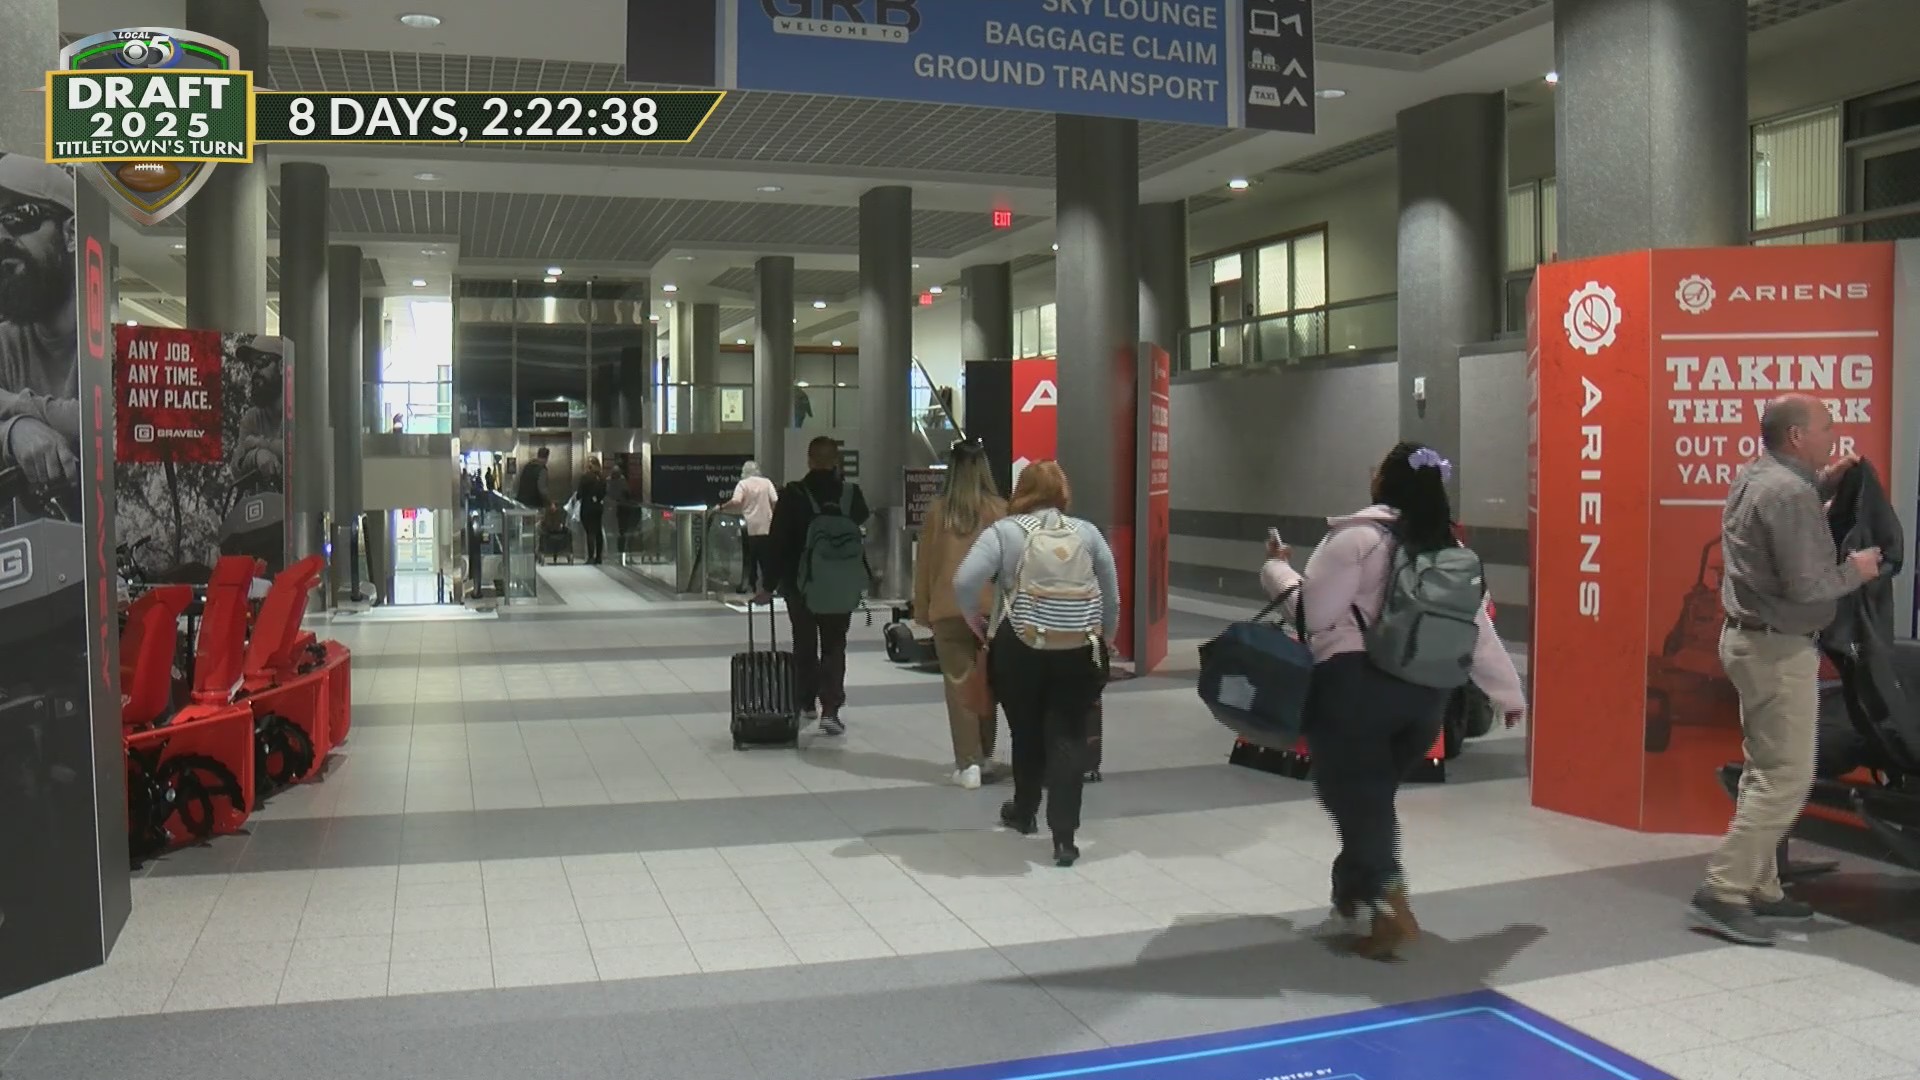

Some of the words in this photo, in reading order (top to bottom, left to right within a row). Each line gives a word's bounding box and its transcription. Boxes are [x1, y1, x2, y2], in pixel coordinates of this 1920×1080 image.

[1042, 0, 1094, 15] SKY
[1105, 0, 1217, 29] LOUNGE
[781, 21, 868, 36] WELCOME
[882, 30, 902, 38] TO
[985, 20, 1125, 55] BAGGAGE
[1132, 35, 1217, 65] CLAIM
[914, 53, 1045, 87] GROUND
[1053, 65, 1219, 102] TRANSPORT
[1255, 91, 1275, 101] TAXI
[994, 211, 1011, 226] EXIT
[1728, 283, 1869, 301] ARIENS
[128, 340, 158, 360] ANY
[164, 343, 194, 363] JOB.
[128, 364, 159, 384] ANY
[165, 367, 202, 387] TIME.
[1666, 355, 1873, 391] TAKING
[128, 388, 159, 408] ANY
[164, 390, 213, 410] PLACE.
[1668, 399, 1742, 424] THE
[1753, 398, 1872, 424] RK
[157, 428, 205, 438] GRAVELY
[1675, 436, 1728, 457] OUT
[1579, 376, 1603, 617] ARIENS
